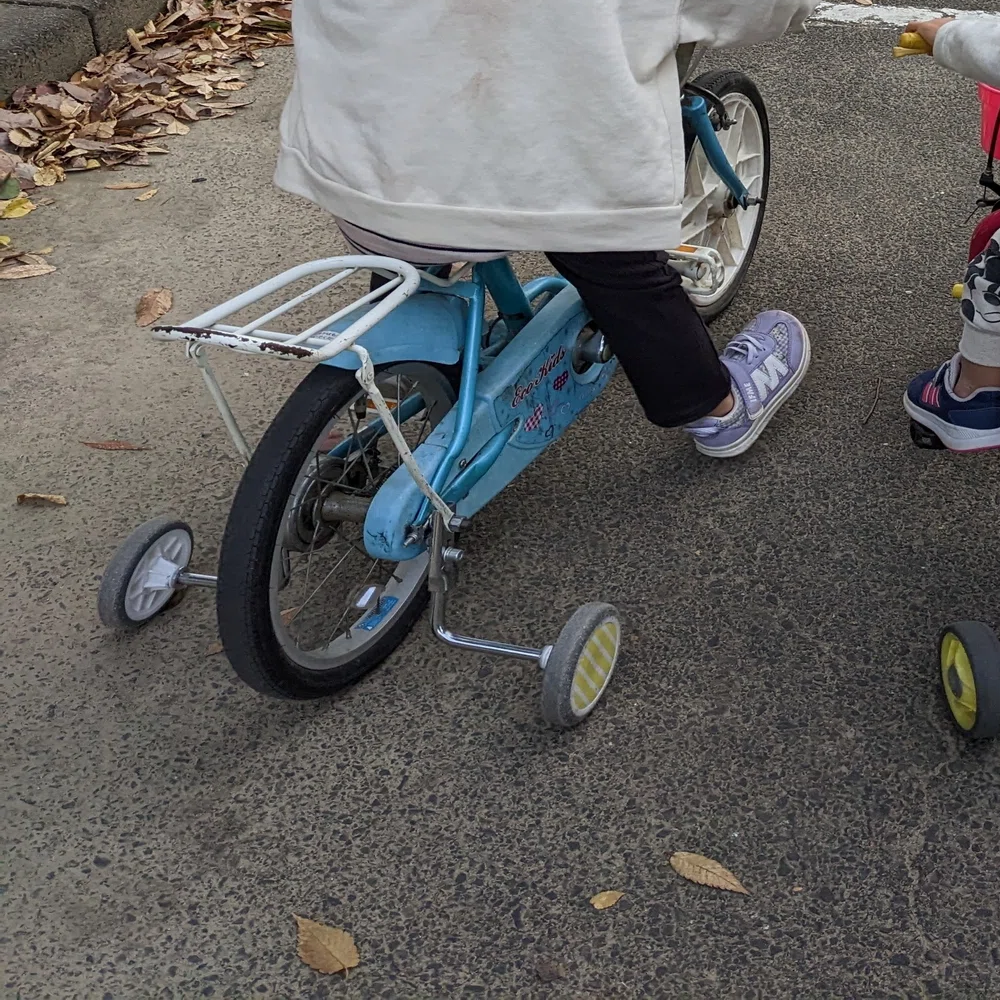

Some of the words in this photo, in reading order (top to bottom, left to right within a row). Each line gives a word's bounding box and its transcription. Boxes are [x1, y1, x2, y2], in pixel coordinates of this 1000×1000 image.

[511, 383, 535, 408] Eco
[534, 344, 567, 382] Kids
[743, 382, 757, 403] IFME
